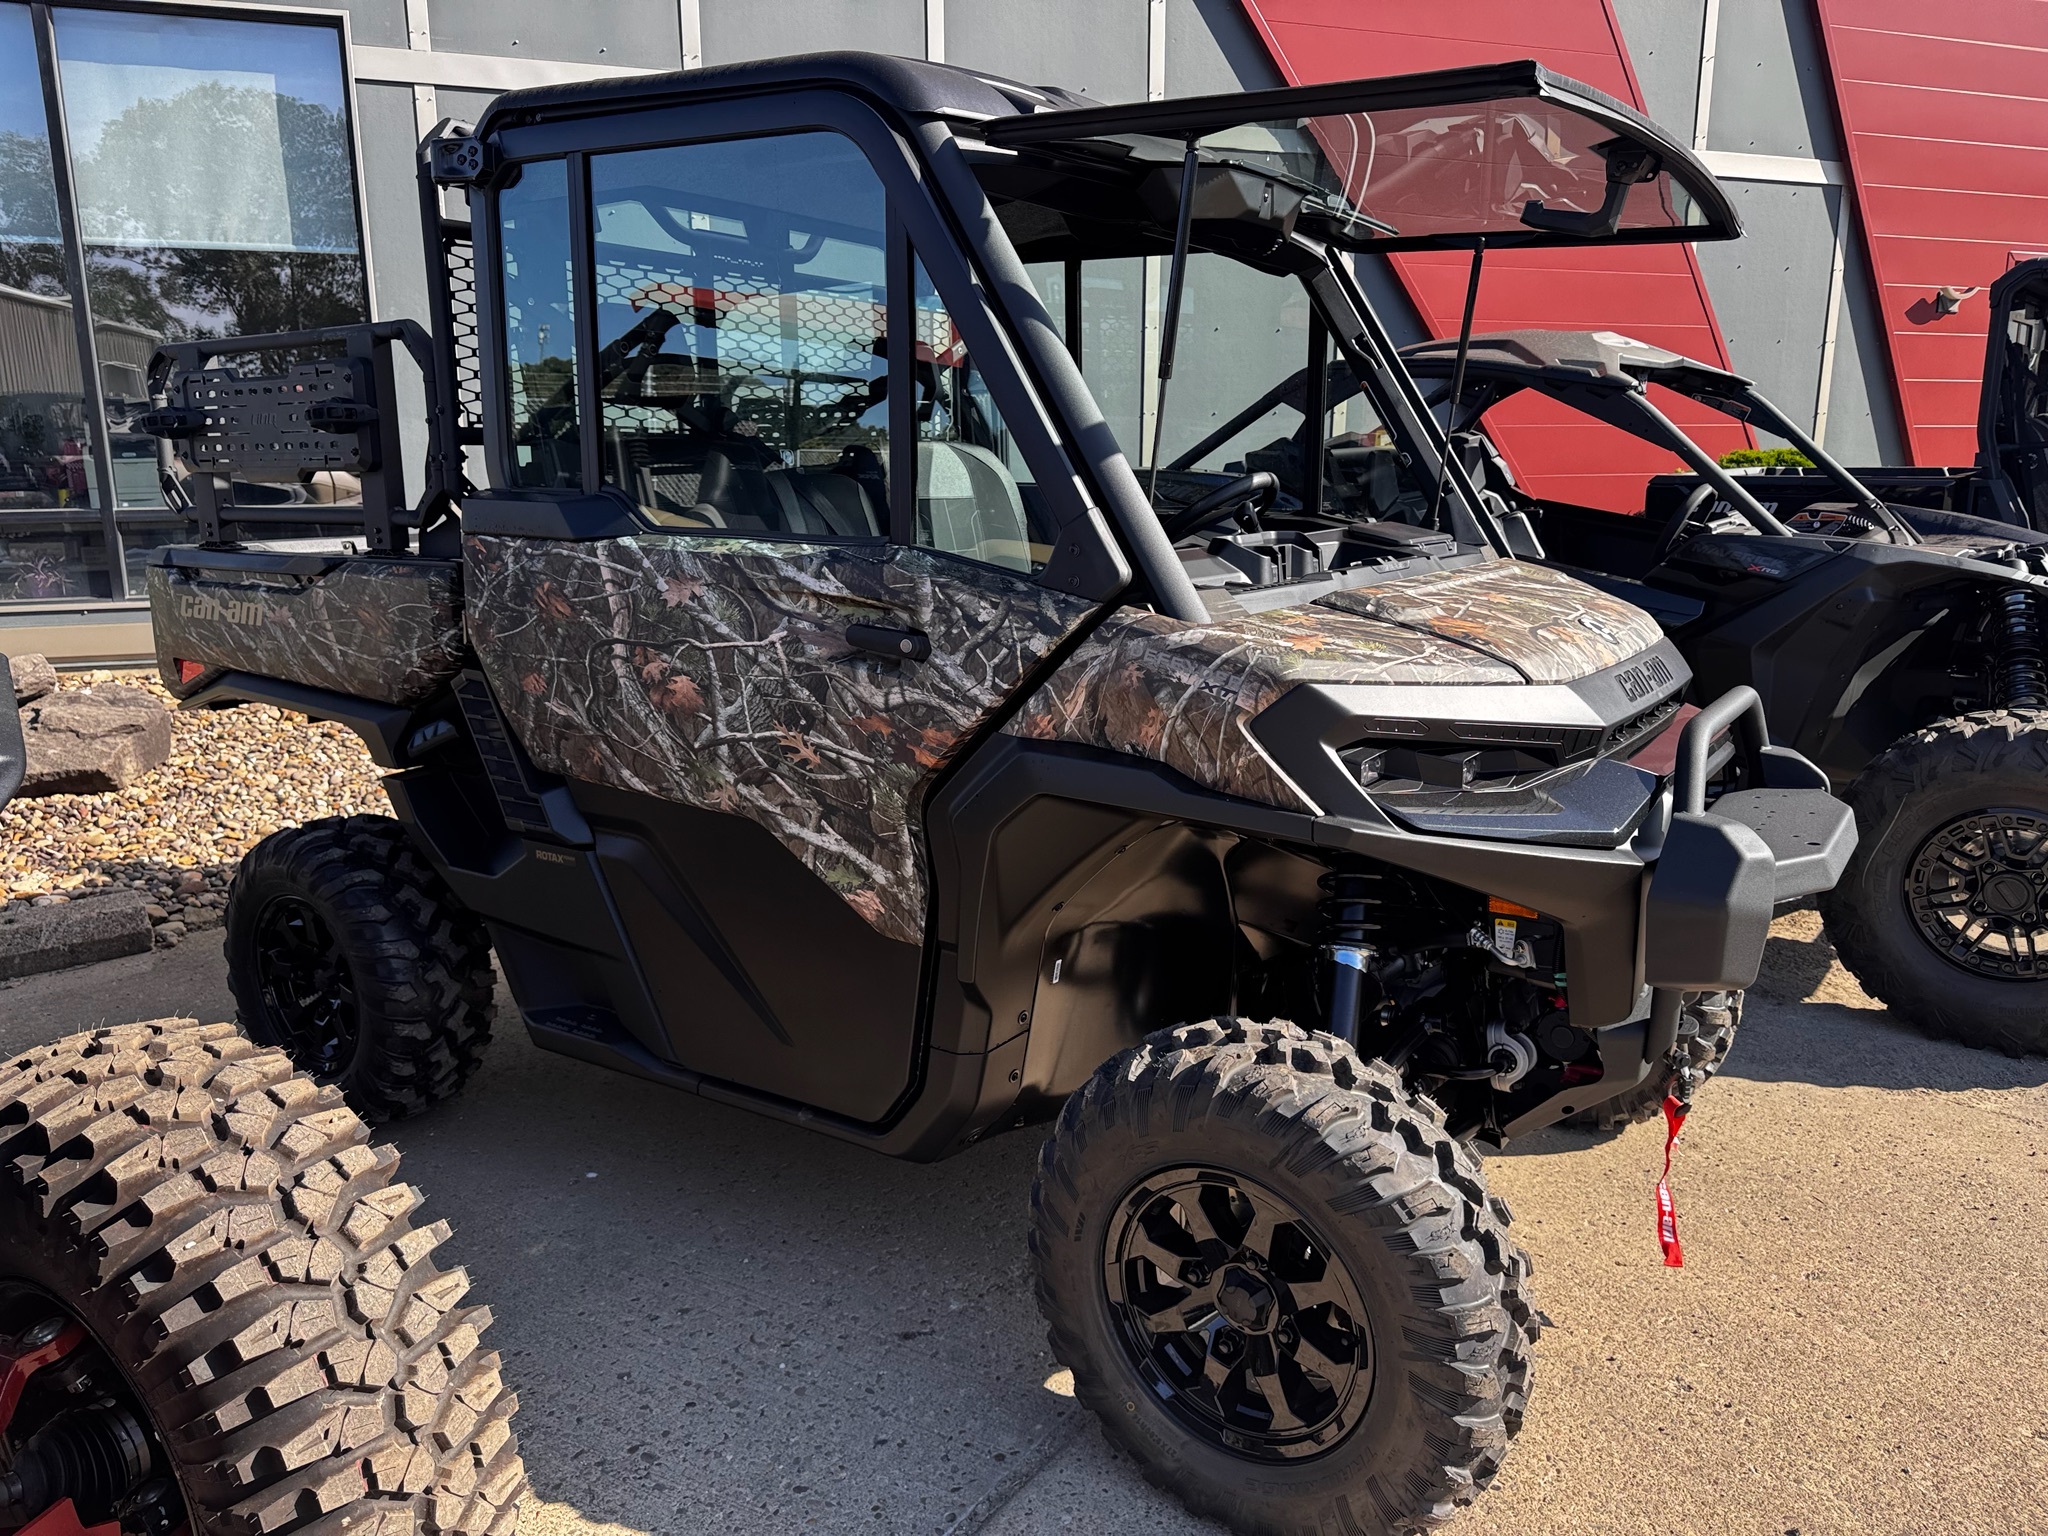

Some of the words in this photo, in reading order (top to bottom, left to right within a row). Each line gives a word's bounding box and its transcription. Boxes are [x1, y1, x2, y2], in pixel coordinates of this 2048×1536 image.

[181, 595, 263, 627] can-am
[1198, 681, 1239, 698] XT
[1614, 655, 1674, 703] can-am
[535, 849, 564, 864] ROTAX
